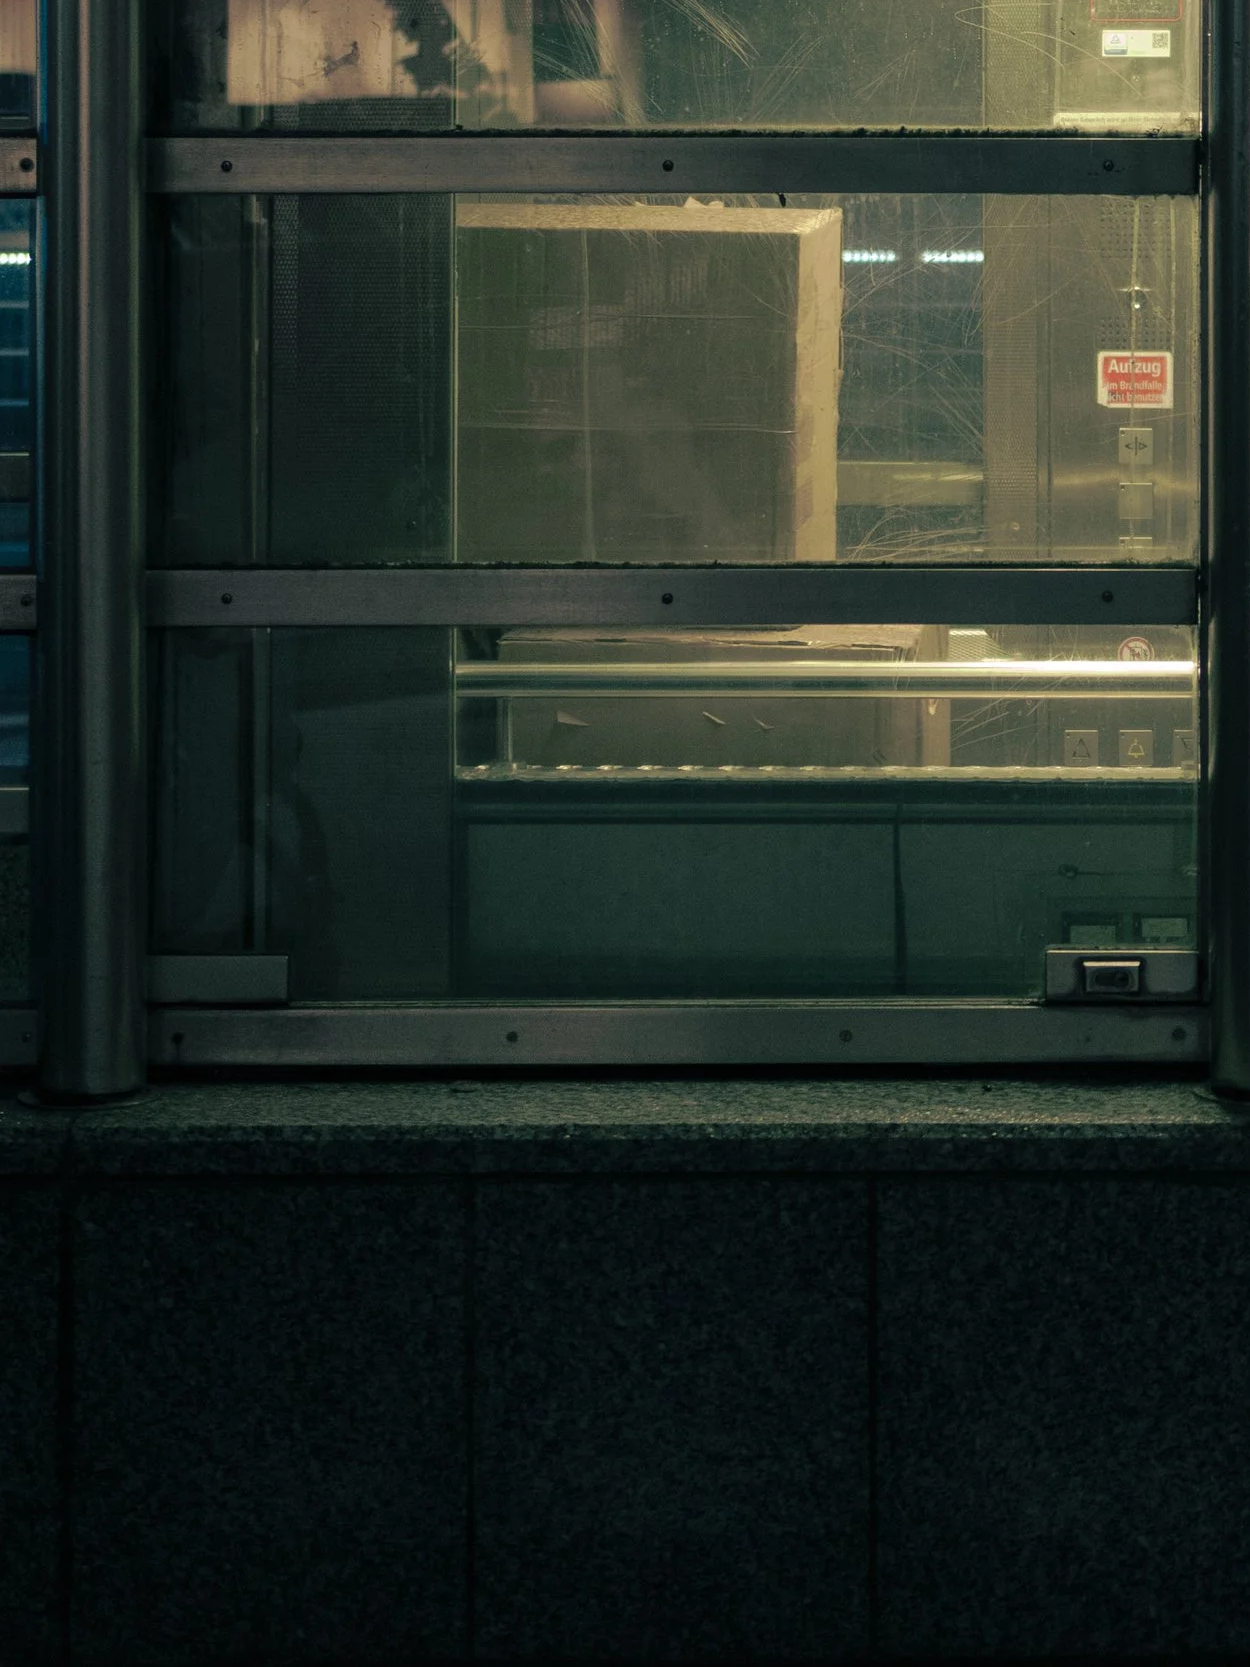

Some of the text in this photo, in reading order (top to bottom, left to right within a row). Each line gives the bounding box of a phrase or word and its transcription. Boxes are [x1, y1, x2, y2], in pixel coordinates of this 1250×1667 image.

[1108, 359, 1161, 377] Aufzug
[1120, 381, 1162, 390] Brandfalle
[1107, 391, 1162, 401] icht benutze
